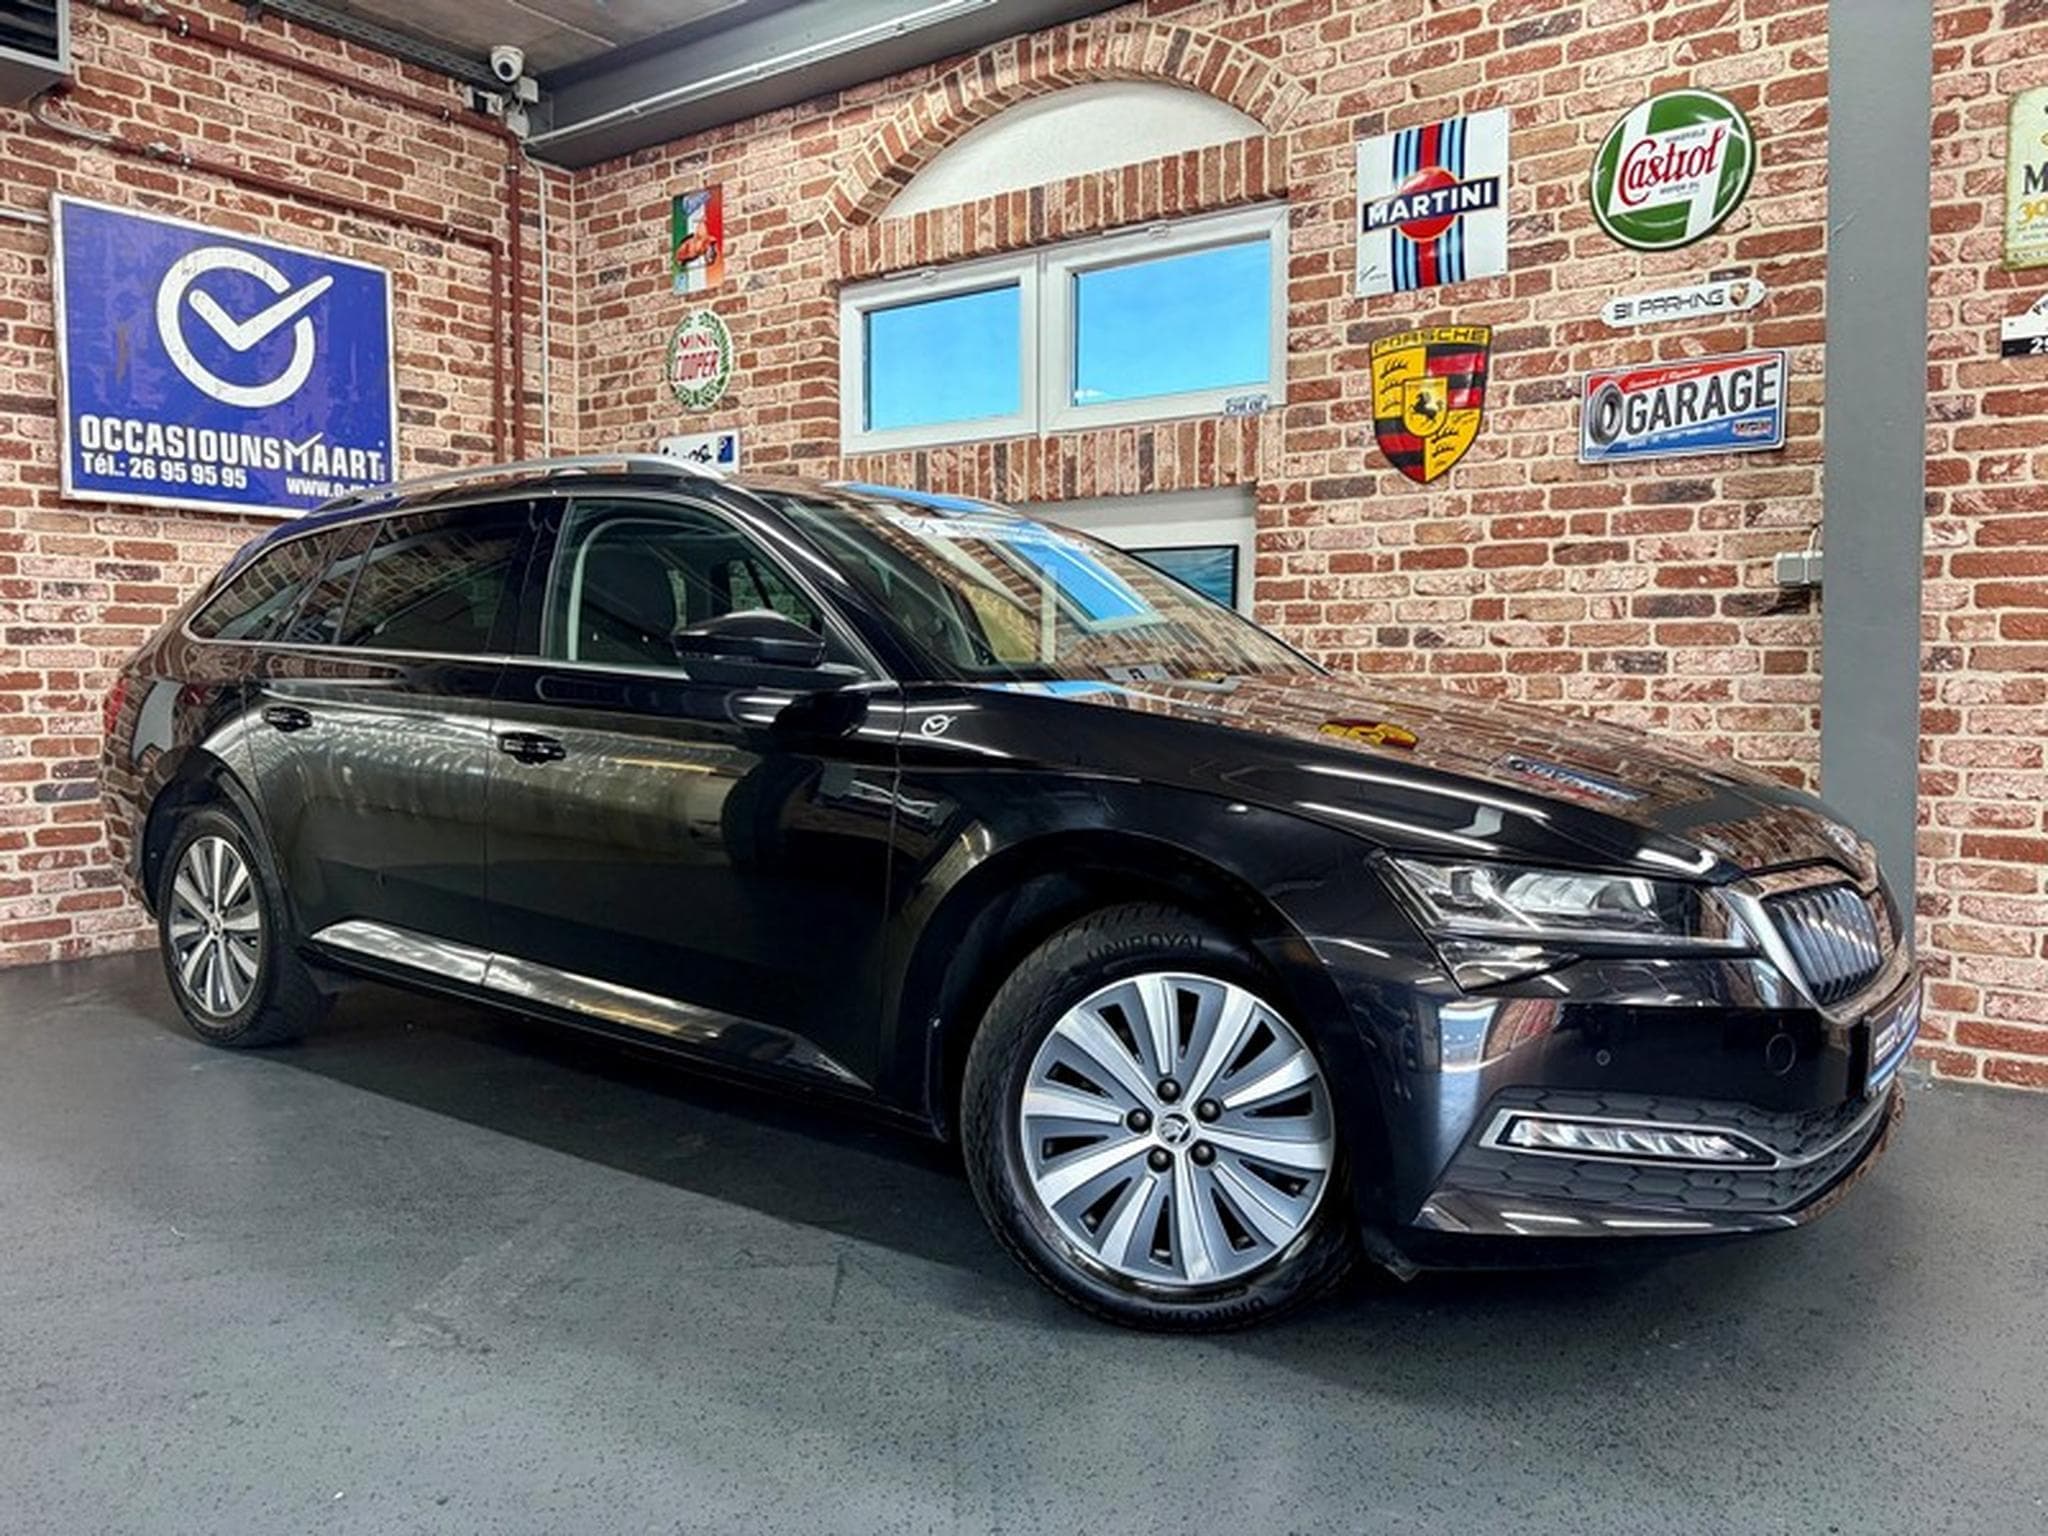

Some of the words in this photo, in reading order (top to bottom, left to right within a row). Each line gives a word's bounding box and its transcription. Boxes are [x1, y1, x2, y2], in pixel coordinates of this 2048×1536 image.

[1618, 124, 1726, 207] Castrol
[1367, 181, 1493, 227] MARTINI
[1638, 289, 1725, 316] PARKING
[1374, 330, 1487, 353] PORSCHE
[1625, 361, 1779, 436] GARAGE
[128, 457, 156, 480] 26
[160, 459, 187, 483] 95
[191, 463, 218, 487] 95
[221, 466, 248, 490] 95
